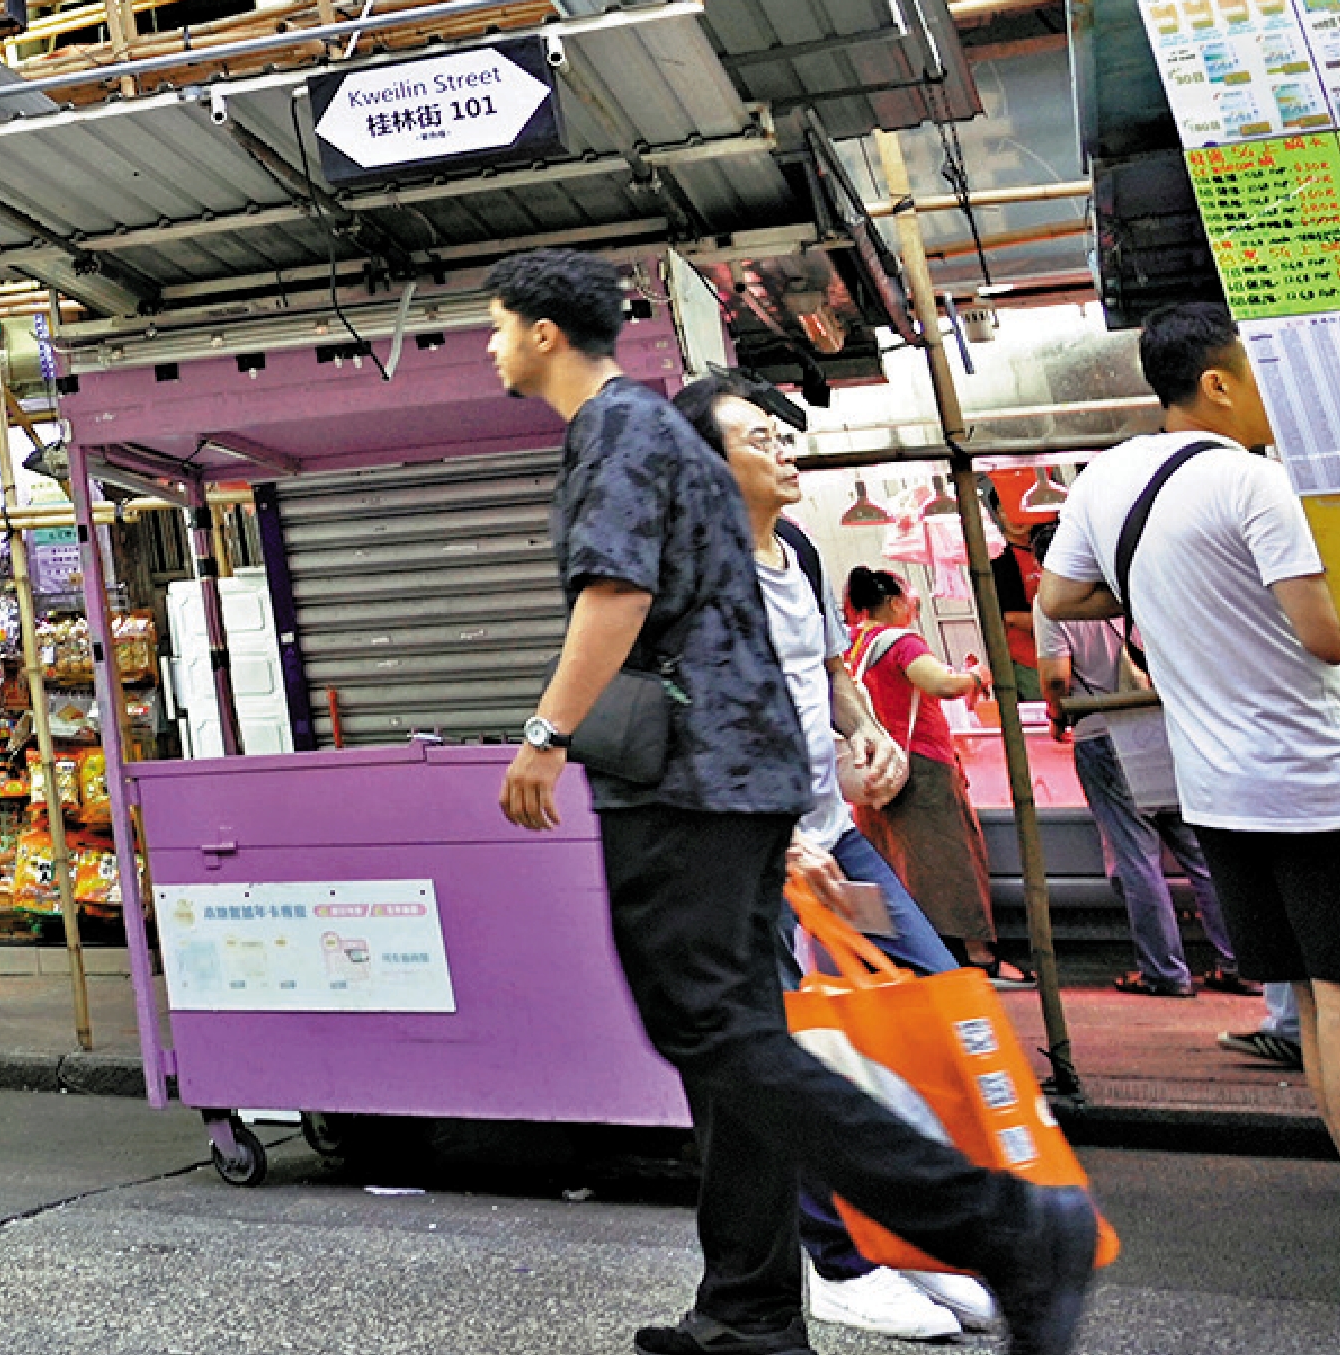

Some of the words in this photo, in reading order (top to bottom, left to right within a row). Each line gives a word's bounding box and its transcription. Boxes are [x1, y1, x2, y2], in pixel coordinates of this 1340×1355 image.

[347, 78, 428, 107] Kweilin
[432, 66, 502, 94] Street
[365, 103, 442, 138] 桂林街
[449, 94, 498, 122] 101
